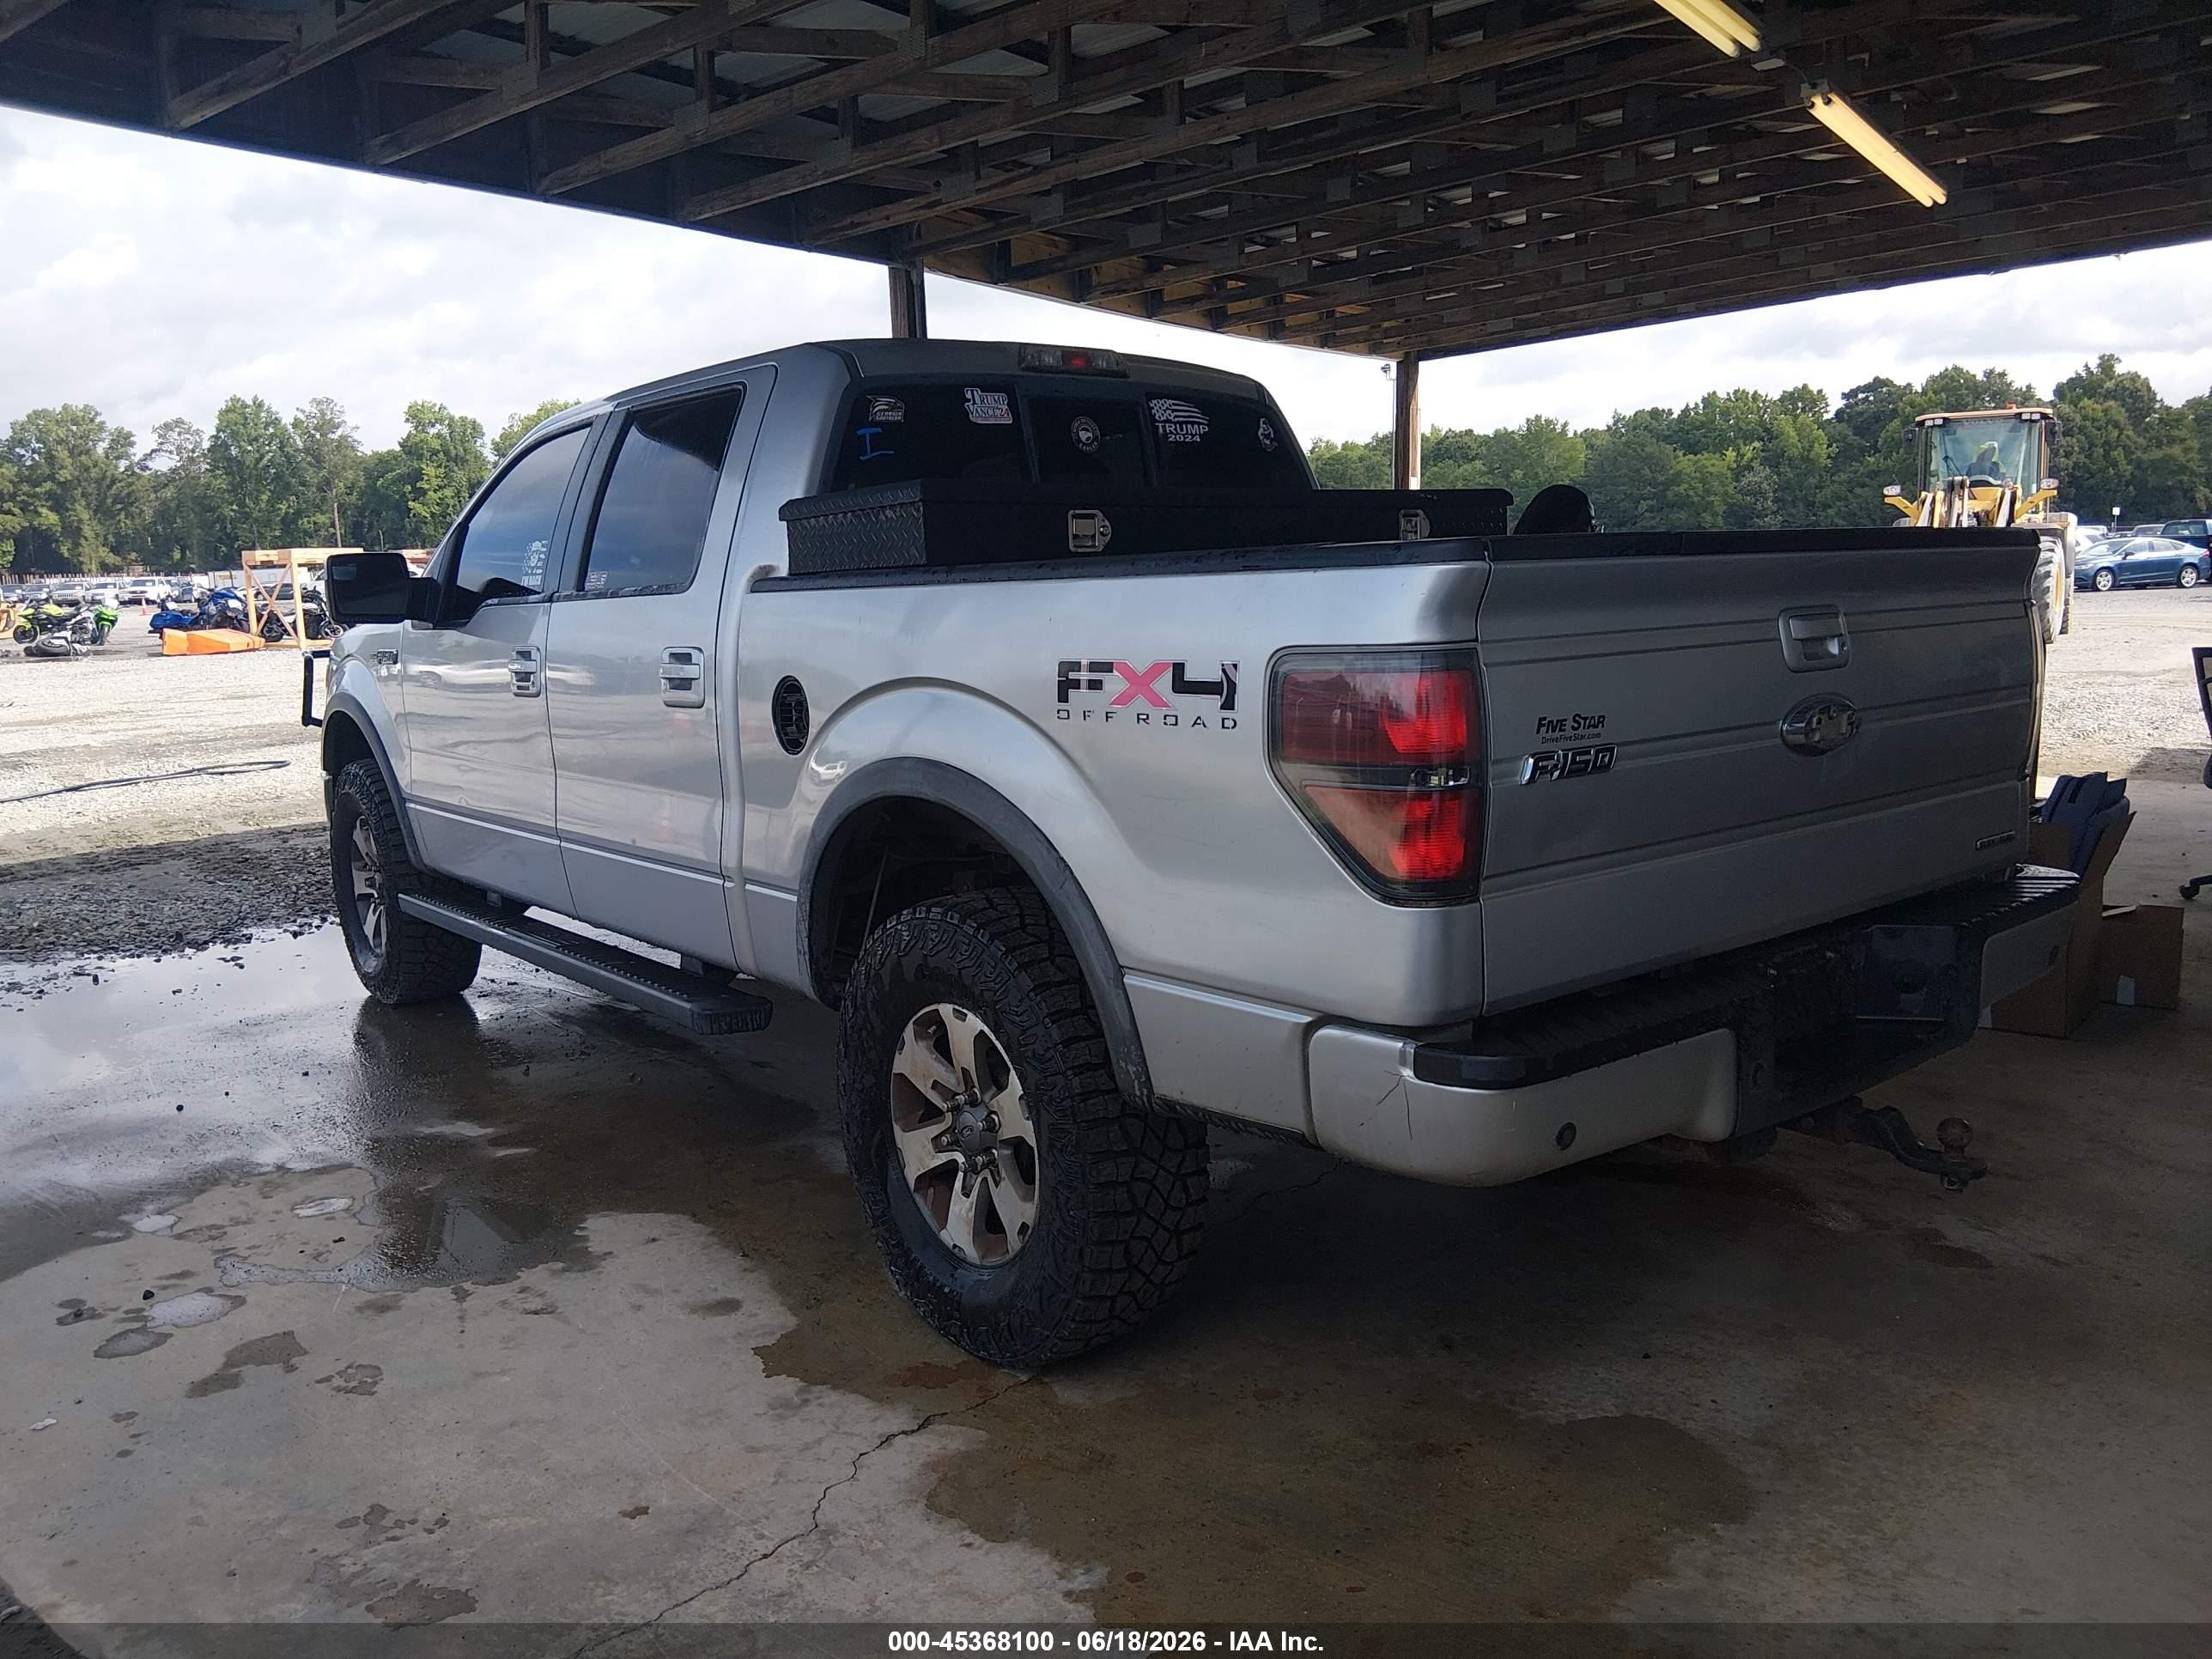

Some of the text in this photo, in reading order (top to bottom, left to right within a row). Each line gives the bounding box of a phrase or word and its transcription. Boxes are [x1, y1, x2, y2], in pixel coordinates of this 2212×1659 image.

[965, 388, 1007, 405] TRUMP
[1155, 422, 1208, 434] TRUMP
[1168, 434, 1201, 442] 2024
[1057, 659, 1239, 713] FX4
[1535, 713, 1606, 734] FIVE STAR
[1540, 732, 1601, 744] DriveFiveStar.com
